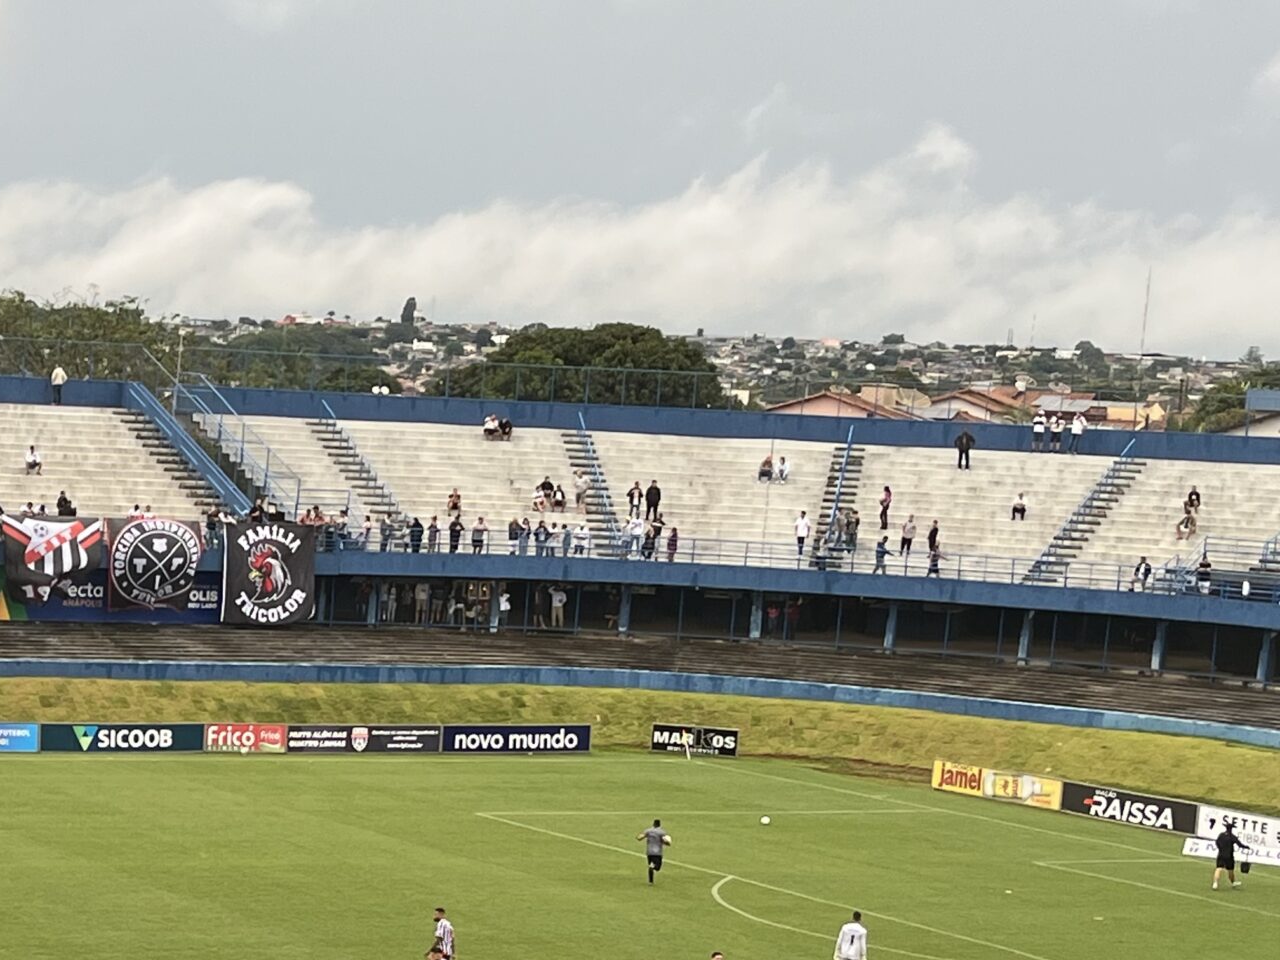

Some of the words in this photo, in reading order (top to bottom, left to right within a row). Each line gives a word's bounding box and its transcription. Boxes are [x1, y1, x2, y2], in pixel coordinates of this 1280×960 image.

[113, 527, 141, 577] TORCIDA
[141, 520, 199, 577] INDEPENDENTE
[236, 524, 302, 554] FAMÍLIA
[133, 558, 147, 574] T
[67, 582, 104, 598] ecta
[189, 590, 219, 602] OLIS
[235, 588, 307, 623] TRICOLOR
[97, 729, 173, 748] SICOOB
[207, 725, 256, 747] Fricó
[454, 732, 504, 750] novo
[508, 728, 578, 750] mundo
[938, 763, 982, 791] jamel
[1089, 795, 1174, 831] RAISSA
[1222, 815, 1268, 834] SETTE
